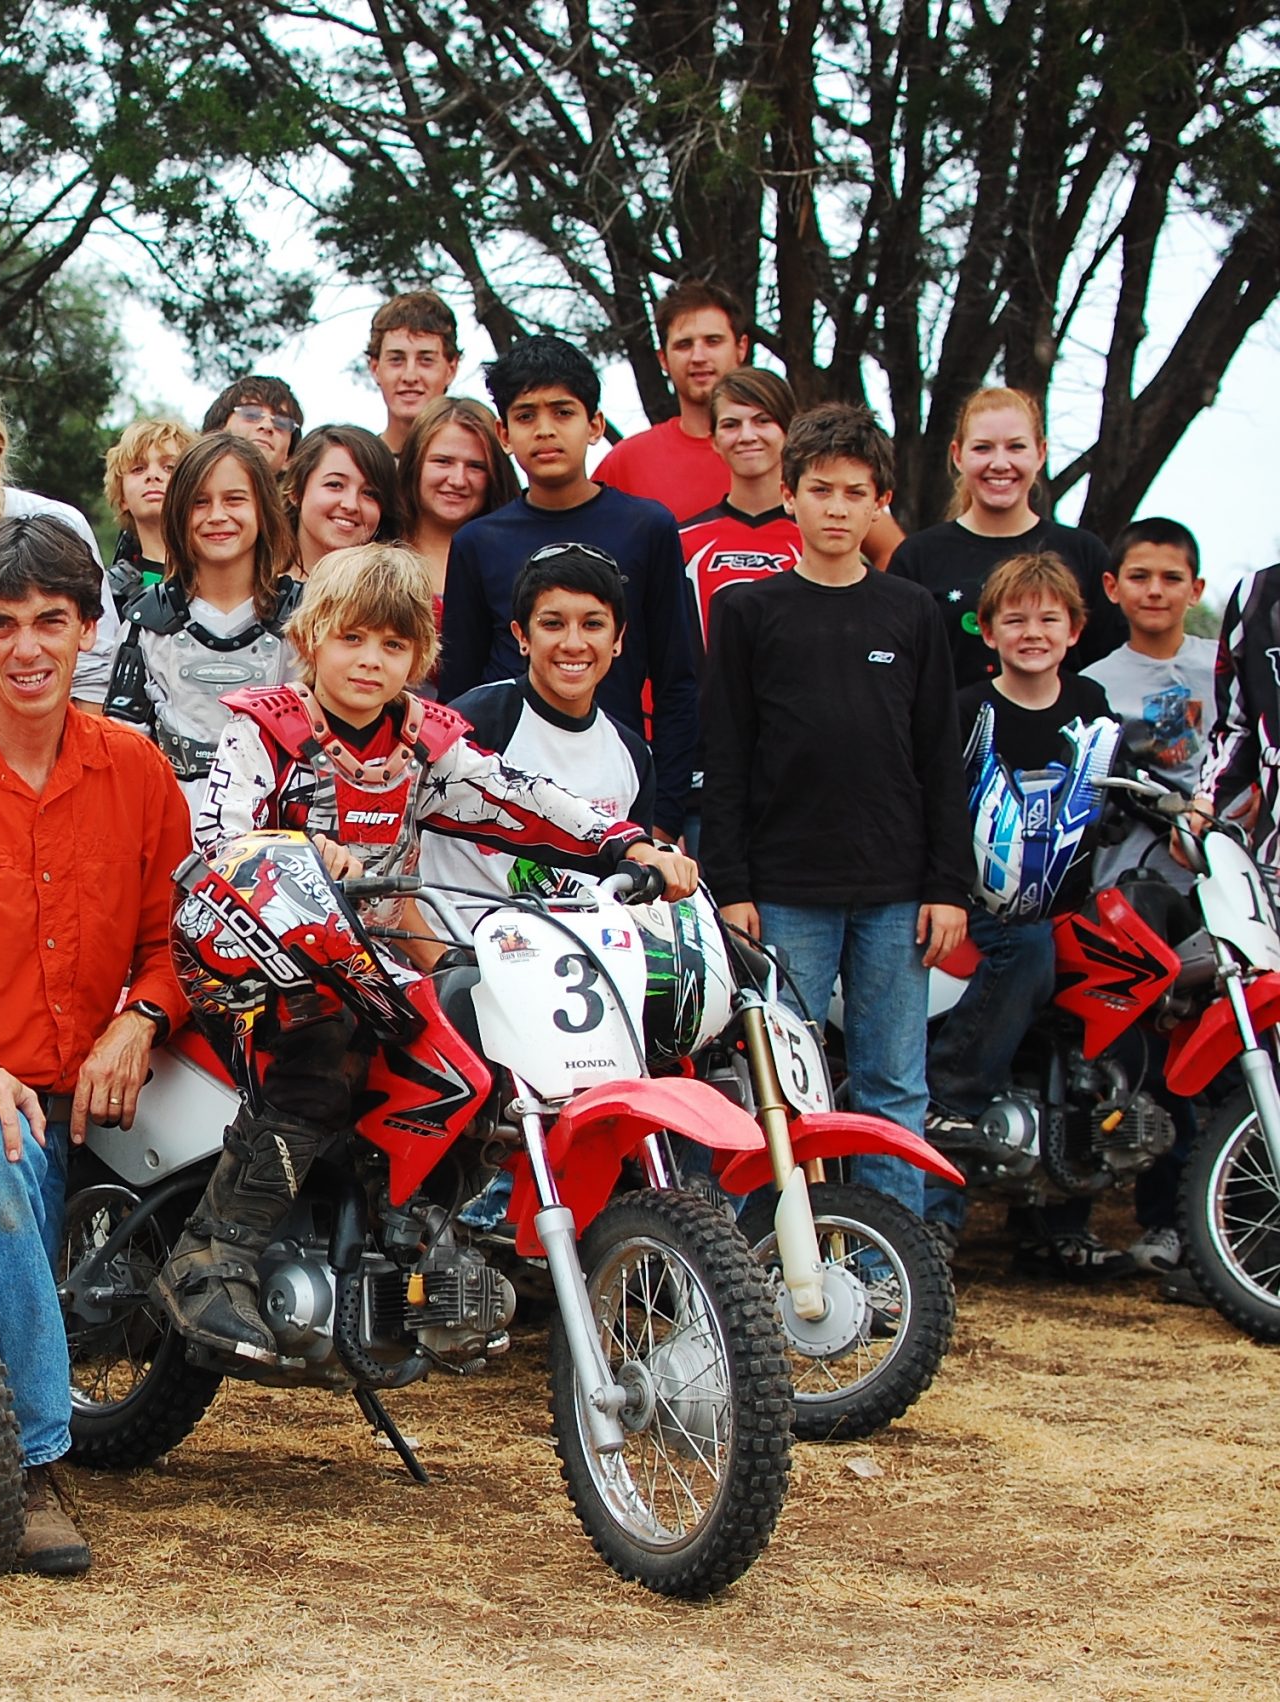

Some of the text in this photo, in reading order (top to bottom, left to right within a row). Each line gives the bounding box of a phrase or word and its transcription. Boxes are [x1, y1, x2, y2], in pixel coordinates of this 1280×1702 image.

[710, 554, 784, 571] FOX
[344, 810, 400, 826] SHIFT
[197, 882, 305, 982] SCOTT
[552, 953, 606, 1034] 3
[564, 1058, 617, 1070] HONDA
[786, 1028, 809, 1095] 5
[416, 1119, 444, 1128] 70F
